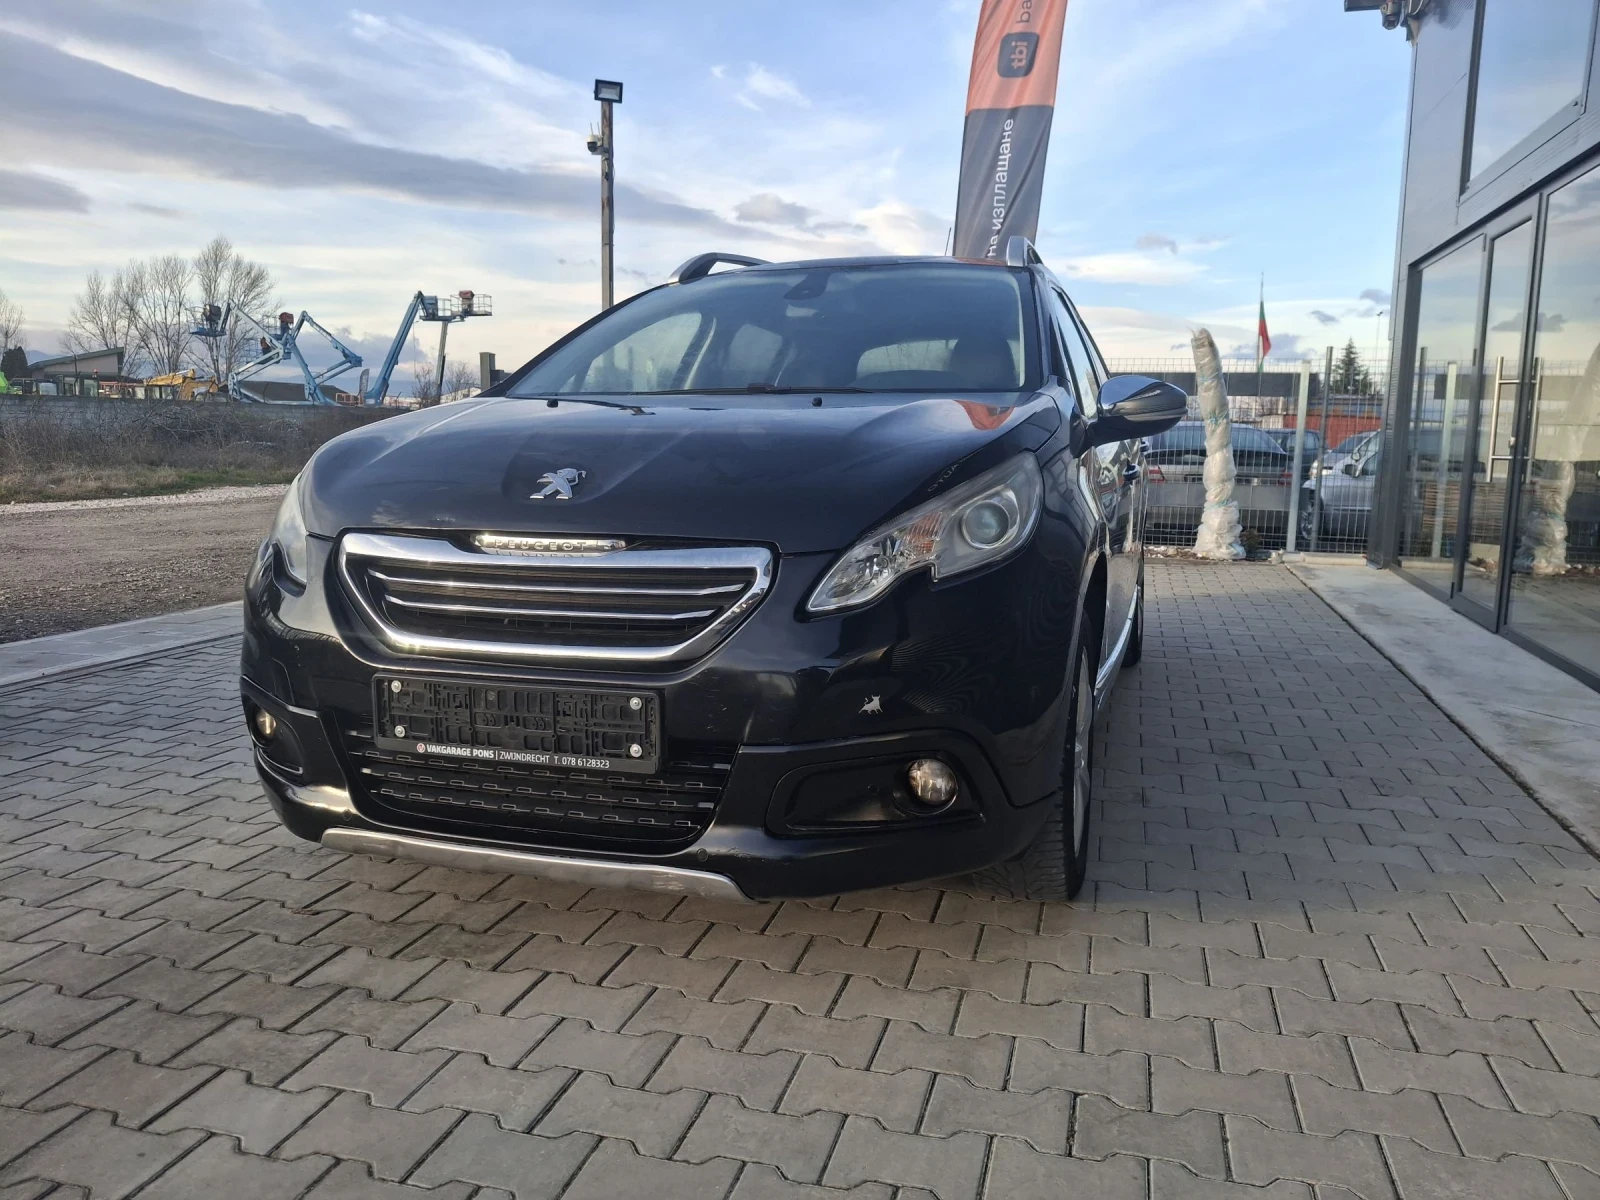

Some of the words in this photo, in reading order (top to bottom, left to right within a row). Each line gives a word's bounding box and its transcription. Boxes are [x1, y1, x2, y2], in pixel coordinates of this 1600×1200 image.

[1010, 41, 1028, 69] tbi
[992, 118, 1014, 231] изплащане
[987, 235, 999, 257] на
[494, 539, 587, 551] PEUGEOT
[426, 744, 471, 756] VAKGARAGE
[472, 749, 495, 759] PONS
[561, 756, 577, 766] 078
[577, 757, 610, 769] 6128323
